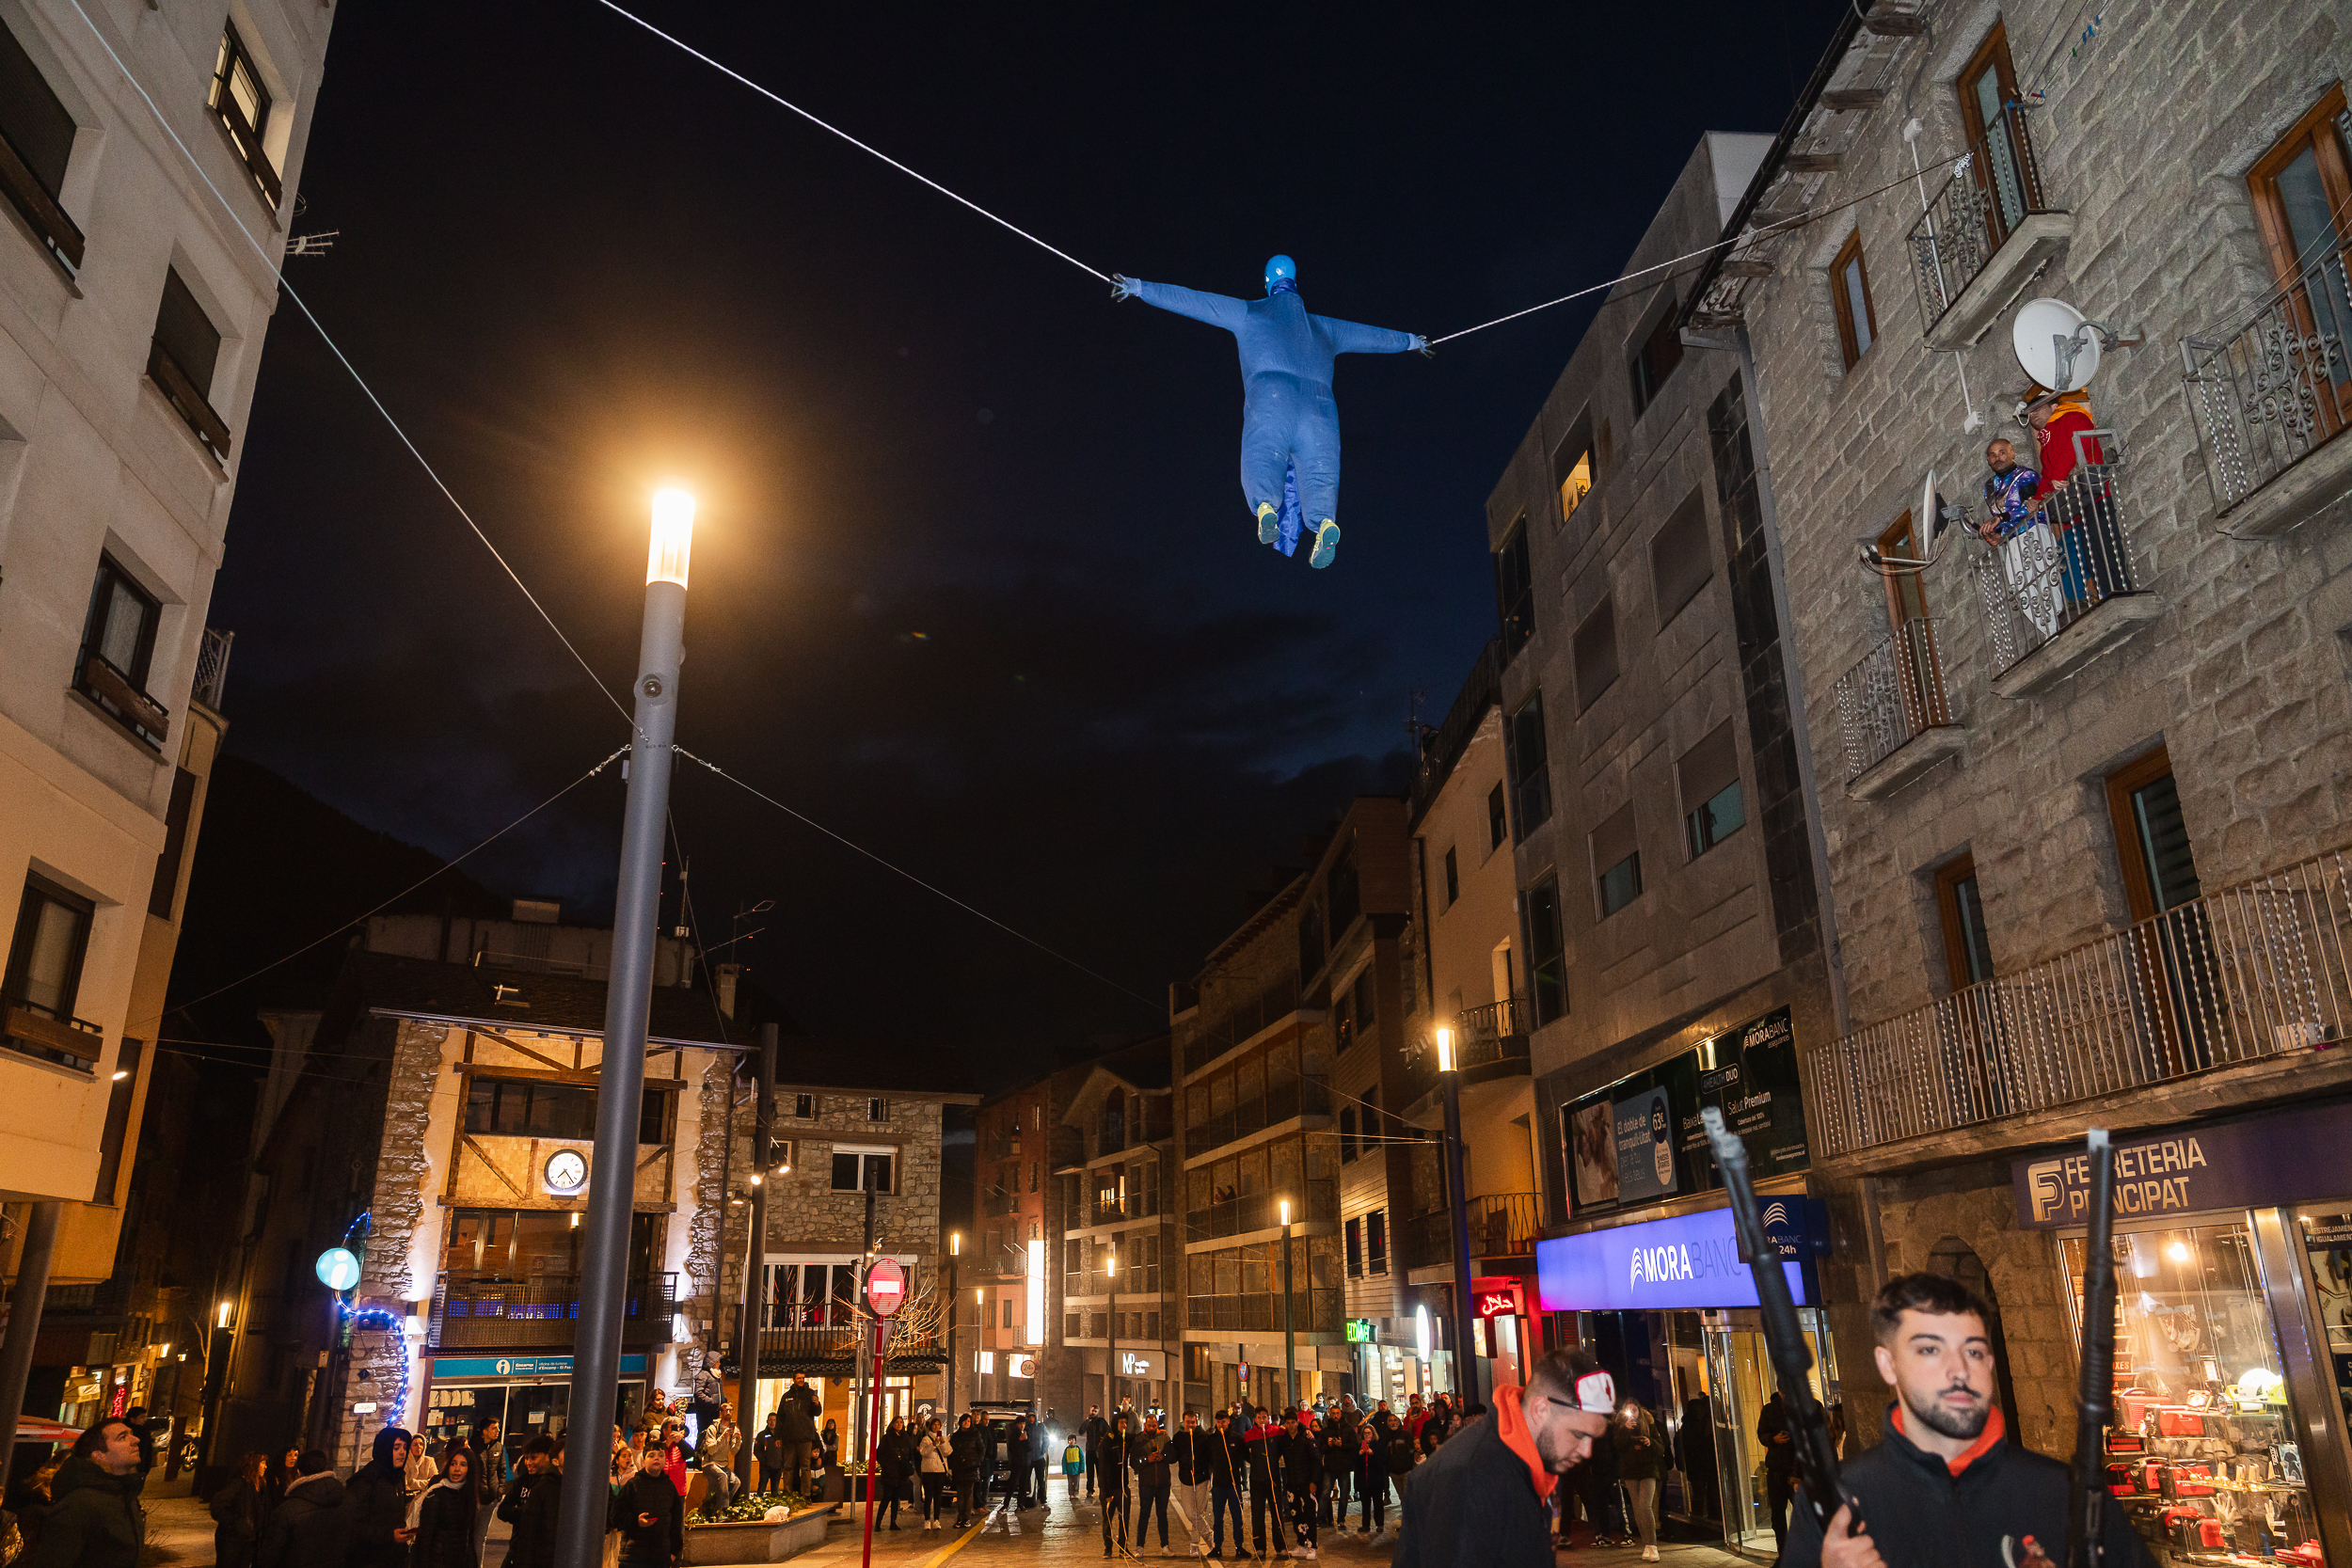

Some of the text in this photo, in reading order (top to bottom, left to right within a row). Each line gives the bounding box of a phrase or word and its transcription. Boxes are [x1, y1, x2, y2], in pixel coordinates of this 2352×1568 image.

[1749, 1018, 1788, 1048] MORABANC
[1768, 1035, 1789, 1049] assegurances
[1725, 1068, 1738, 1083] DUO
[1743, 1091, 1772, 1110] Premium
[1624, 1117, 1638, 1133] doble
[1639, 1113, 1646, 1128] de
[2064, 1137, 2207, 1185] FEETERIA
[2070, 1177, 2190, 1218] PNCIPAT
[1644, 1236, 1741, 1282] MORABANC
[1779, 1244, 1797, 1255] 24h
